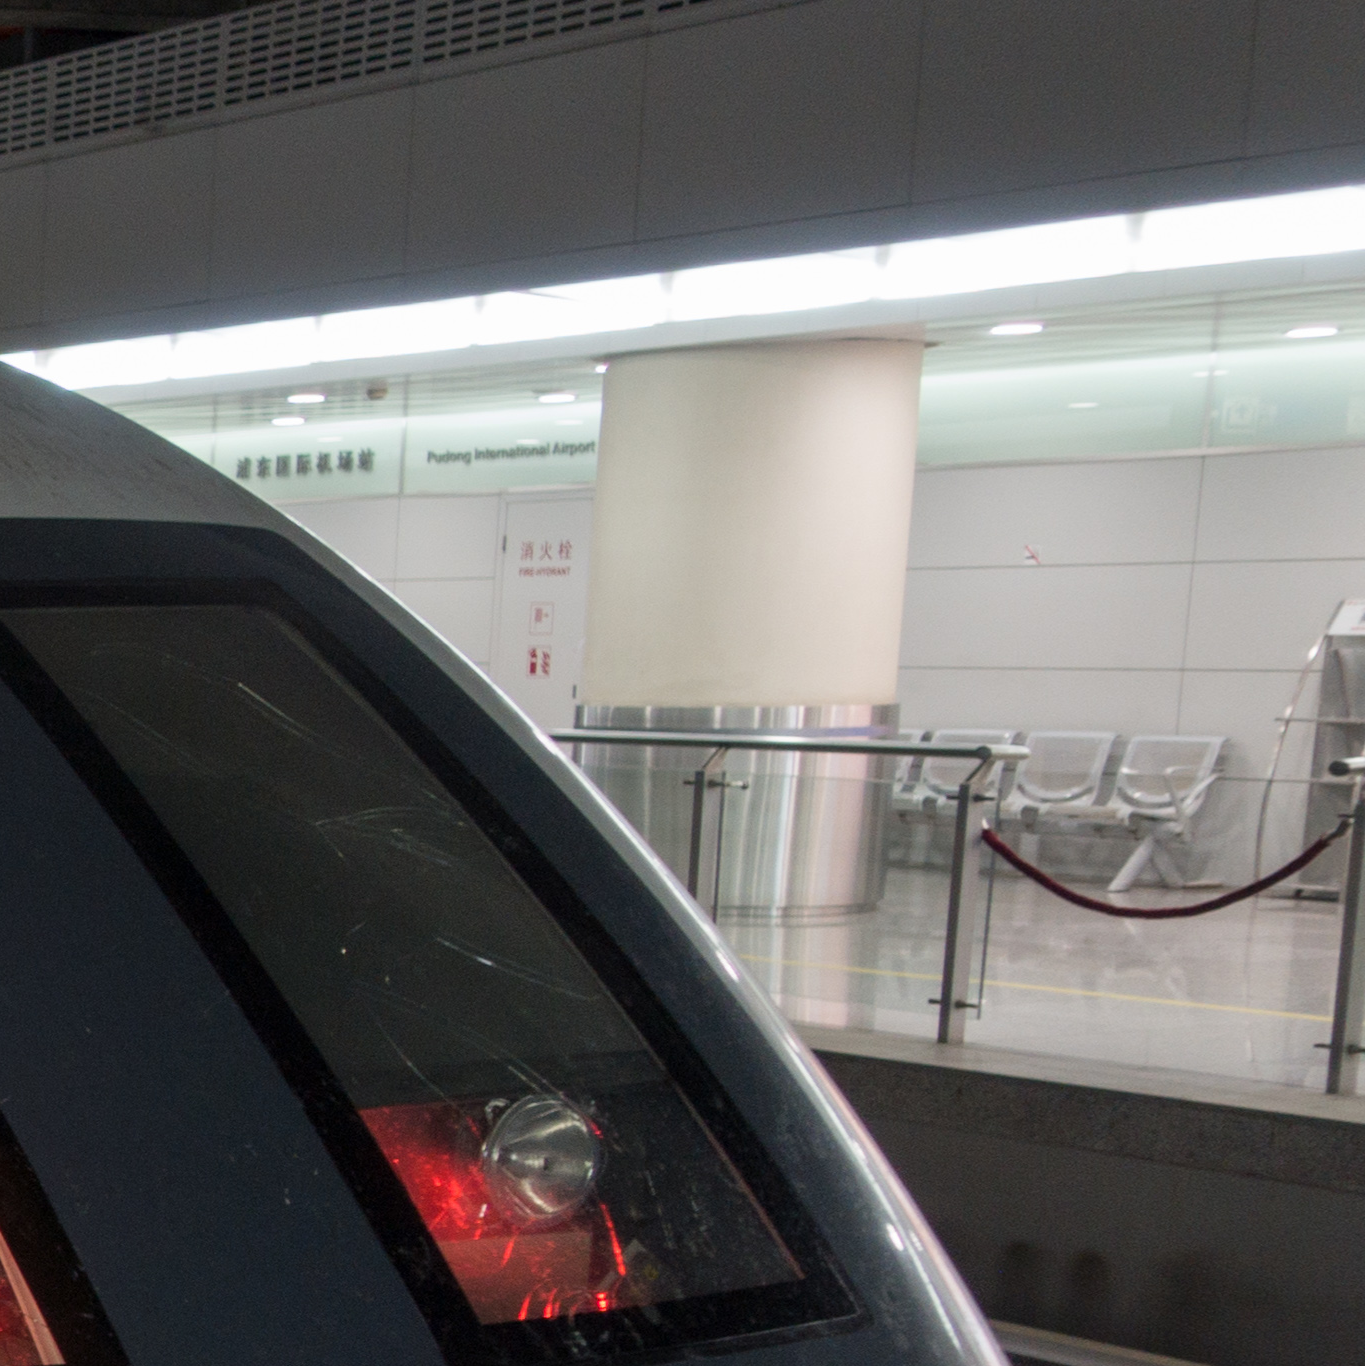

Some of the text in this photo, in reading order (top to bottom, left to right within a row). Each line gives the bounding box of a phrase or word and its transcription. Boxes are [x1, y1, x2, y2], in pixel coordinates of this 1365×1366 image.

[427, 440, 596, 465] Pudong International Airport
[520, 539, 573, 562] 消火栓
